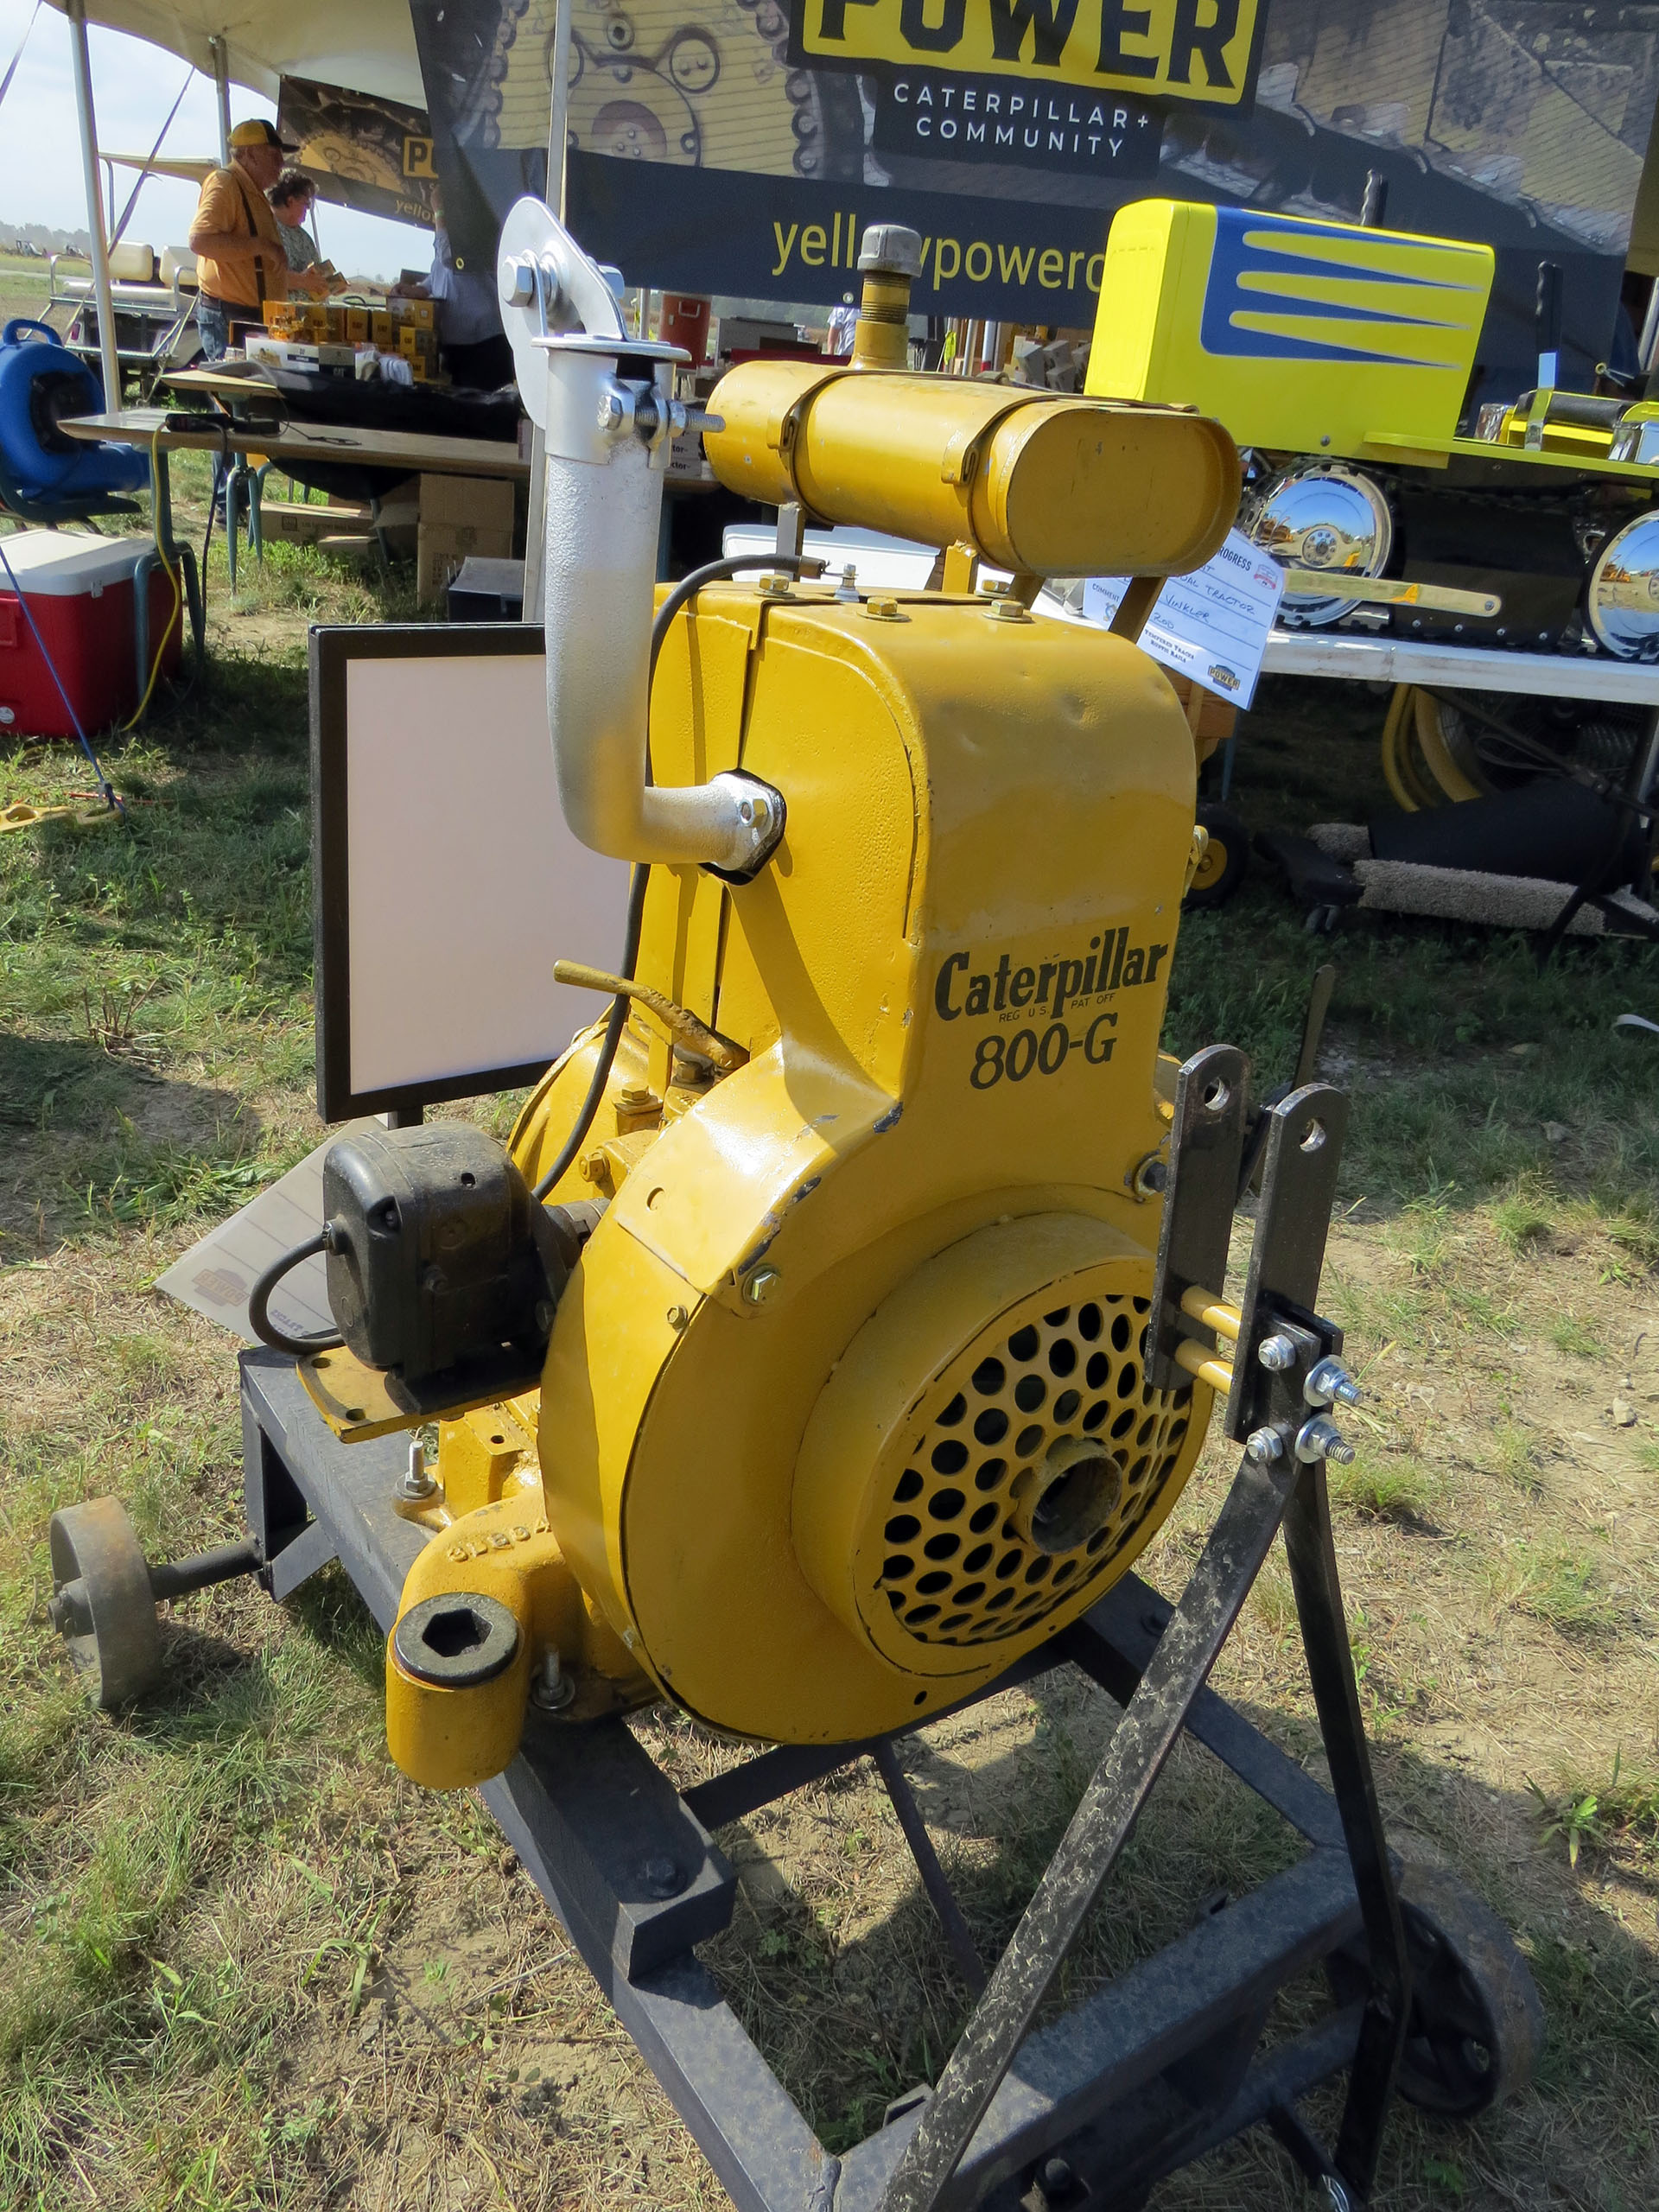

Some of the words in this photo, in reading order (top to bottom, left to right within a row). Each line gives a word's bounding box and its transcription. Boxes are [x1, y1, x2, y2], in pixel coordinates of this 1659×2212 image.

[916, 118, 1123, 157] COMMUNITY
[395, 200, 436, 224] yello
[1217, 546, 1252, 571] ROGRESS
[1210, 667, 1238, 689] POWER
[935, 926, 1168, 1021] Caterpillar
[999, 1011, 1020, 1023] REG
[1071, 997, 1090, 1010] PAT
[1096, 993, 1116, 1005] OFF
[969, 1013, 1118, 1090] 800-G
